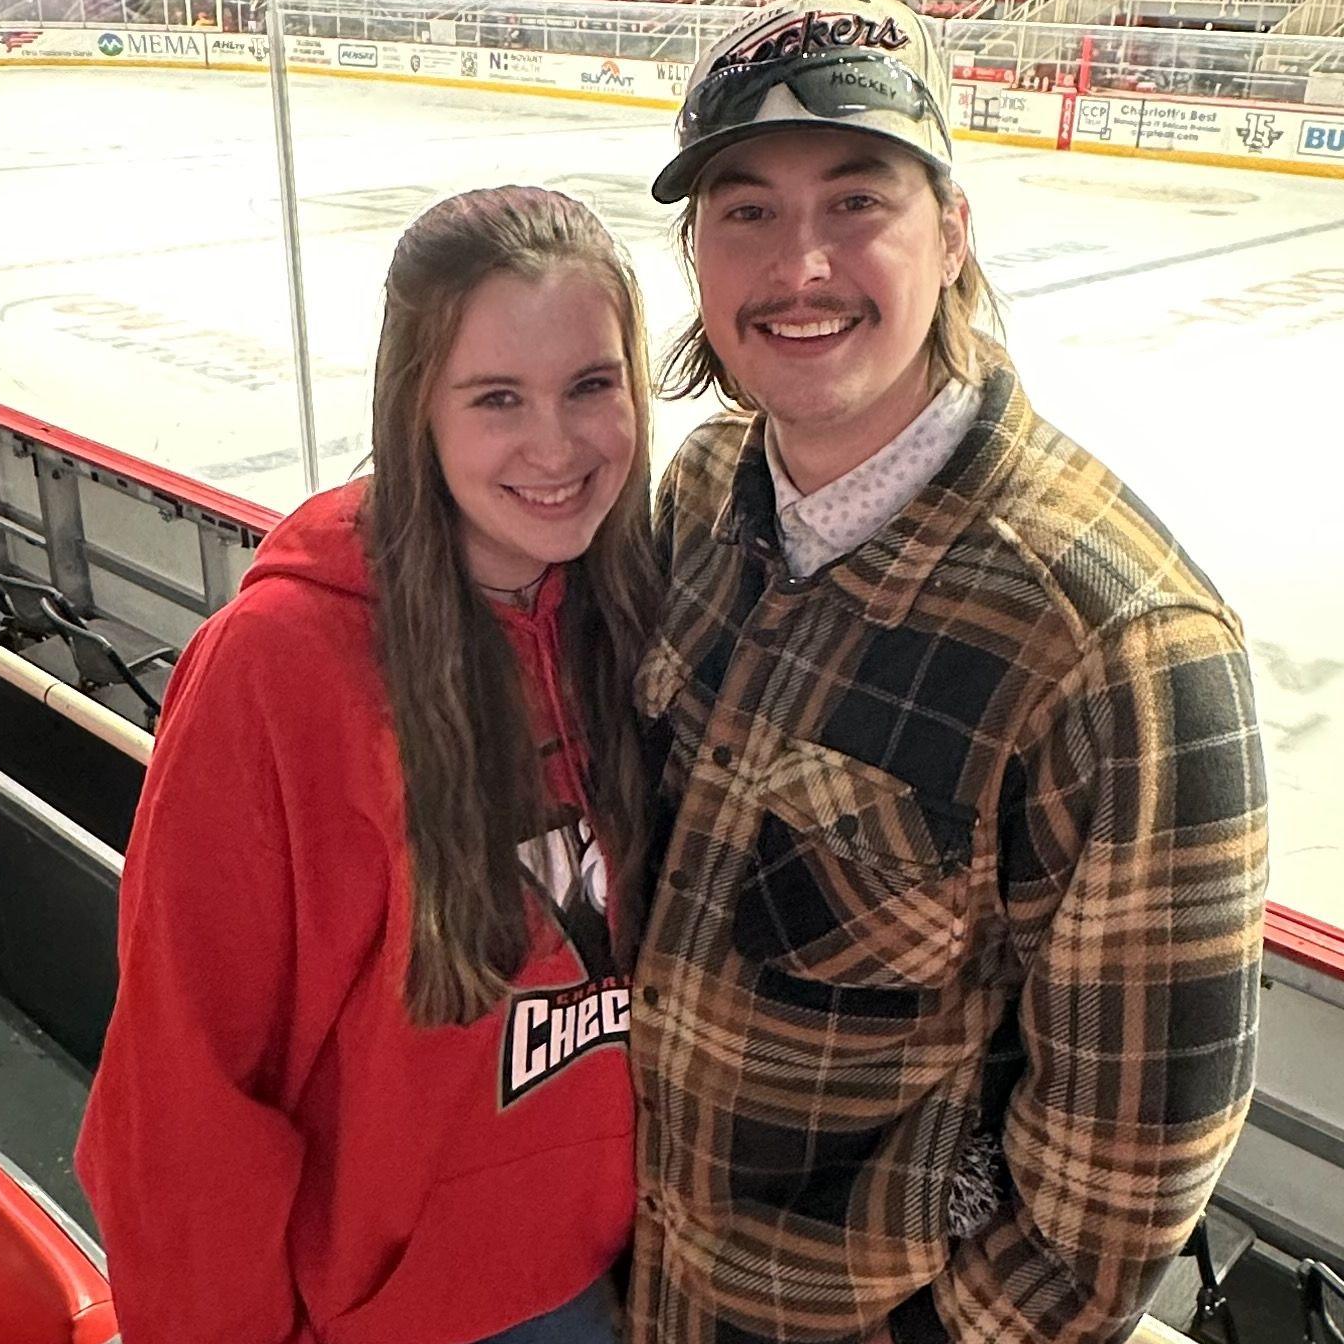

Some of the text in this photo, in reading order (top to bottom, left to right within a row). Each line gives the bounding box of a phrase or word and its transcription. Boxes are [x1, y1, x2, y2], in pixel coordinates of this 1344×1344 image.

[128, 34, 201, 55] MEMA
[831, 70, 897, 101] HOCKEY
[1081, 105, 1107, 118] CCP
